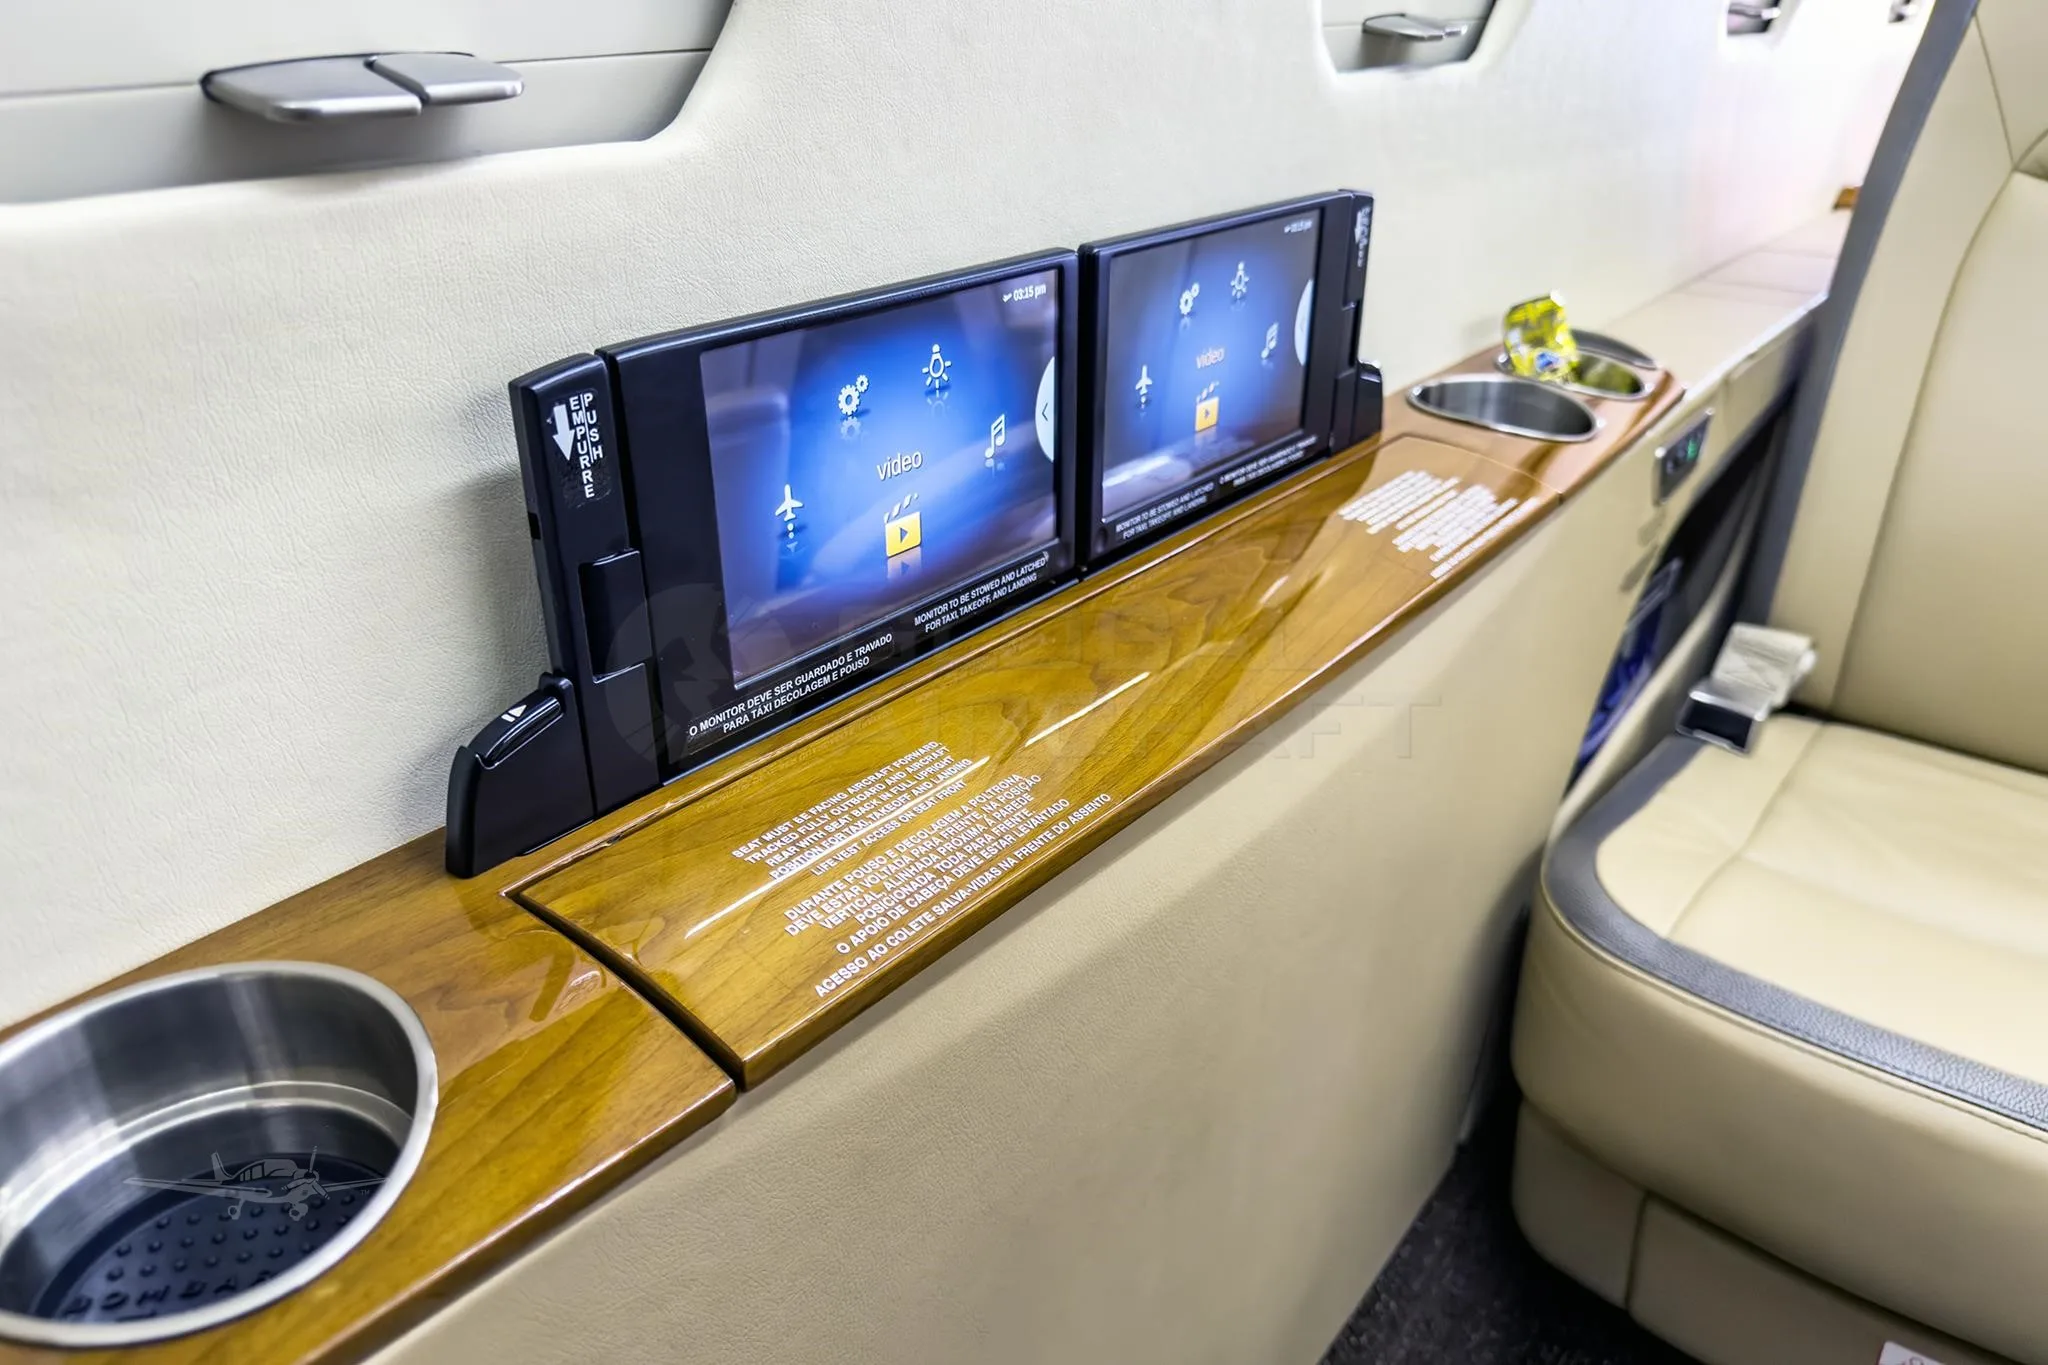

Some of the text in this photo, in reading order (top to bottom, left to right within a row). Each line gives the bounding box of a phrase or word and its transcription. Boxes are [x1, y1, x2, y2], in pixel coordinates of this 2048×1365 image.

[1013, 283, 1047, 301] 03:15 pm
[1195, 348, 1225, 369] video
[569, 396, 595, 498] EMPURRE
[583, 392, 603, 460] PUSH
[876, 451, 922, 480] video
[914, 557, 1046, 626] MONITOR TO BE STOWED AND LATCHED
[925, 573, 1037, 633] FOR TAXI, TAKEOFF, AND LANDING
[689, 633, 892, 736] O MONITOR DEVE SER GUARDADO E TRAVADO
[723, 656, 870, 733] PARA TÁXI DECOLAGEM E POUSO
[732, 838, 763, 858] SEAT
[761, 821, 794, 842] MUST
[792, 813, 812, 824] BE
[808, 792, 848, 816] FACING
[847, 765, 895, 795] AIRCRAFT
[744, 746, 950, 864] TRACKED FULLY OUTBOARD AND AIRCRAFT
[765, 755, 955, 867] REAR WITH SEAT BACK IN FULL UPRIGHT
[769, 845, 823, 880] POSITION
[821, 832, 847, 850] FOR
[910, 781, 933, 797] AND
[931, 758, 973, 784] LANDING
[784, 774, 1024, 920] DURANTE POUSO E DECOLAGEM A POLTRONA
[810, 779, 967, 876] LIFE VEST ACCESS ON SEAT FRONT
[784, 909, 825, 936] DEVE
[820, 885, 865, 914] ESTAR
[859, 854, 915, 888] VOLTADA
[910, 836, 944, 859] PARA
[980, 800, 1001, 814] NA
[815, 793, 1112, 998] ACESSO AO COLETE SALVA-VIDAS NA FRENTE DO ASSENTO
[820, 890, 887, 929] VERTICAL,
[882, 852, 941, 892] ALINHADA
[992, 793, 1035, 820] PAREDE
[836, 798, 1070, 954] O APOIO DE CABEÇA DEVE ESTAR LEVANTADO
[855, 871, 937, 924] POSICIONADA
[933, 851, 968, 873] TODA
[963, 832, 996, 855] PARA
